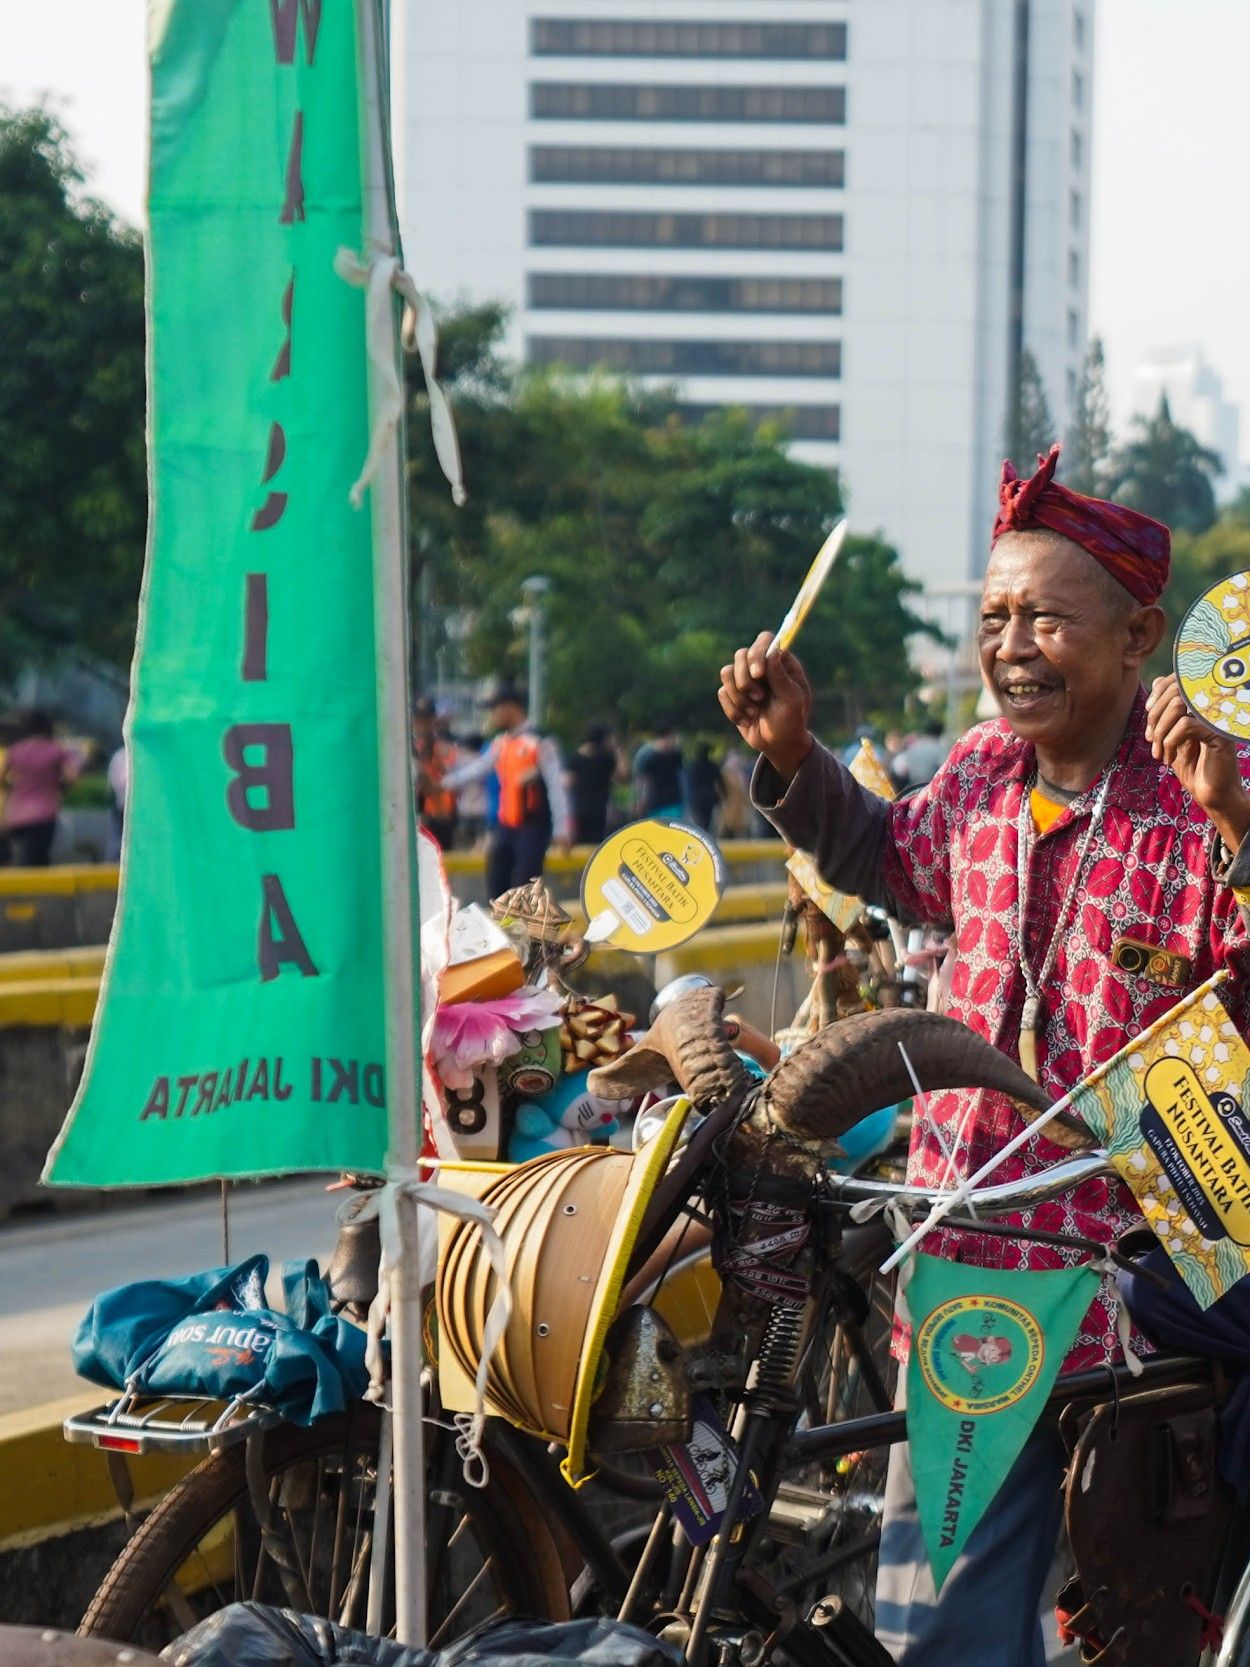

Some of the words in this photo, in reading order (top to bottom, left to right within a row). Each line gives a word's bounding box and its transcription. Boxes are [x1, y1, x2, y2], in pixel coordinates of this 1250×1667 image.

[1167, 1103, 1234, 1214] NUSANTARA
[1173, 1075, 1225, 1160] FESTIVAL
[1027, 1328, 1040, 1362] SEPEDA
[956, 1420, 975, 1453] DKI
[939, 1457, 968, 1548] JAKARTA
